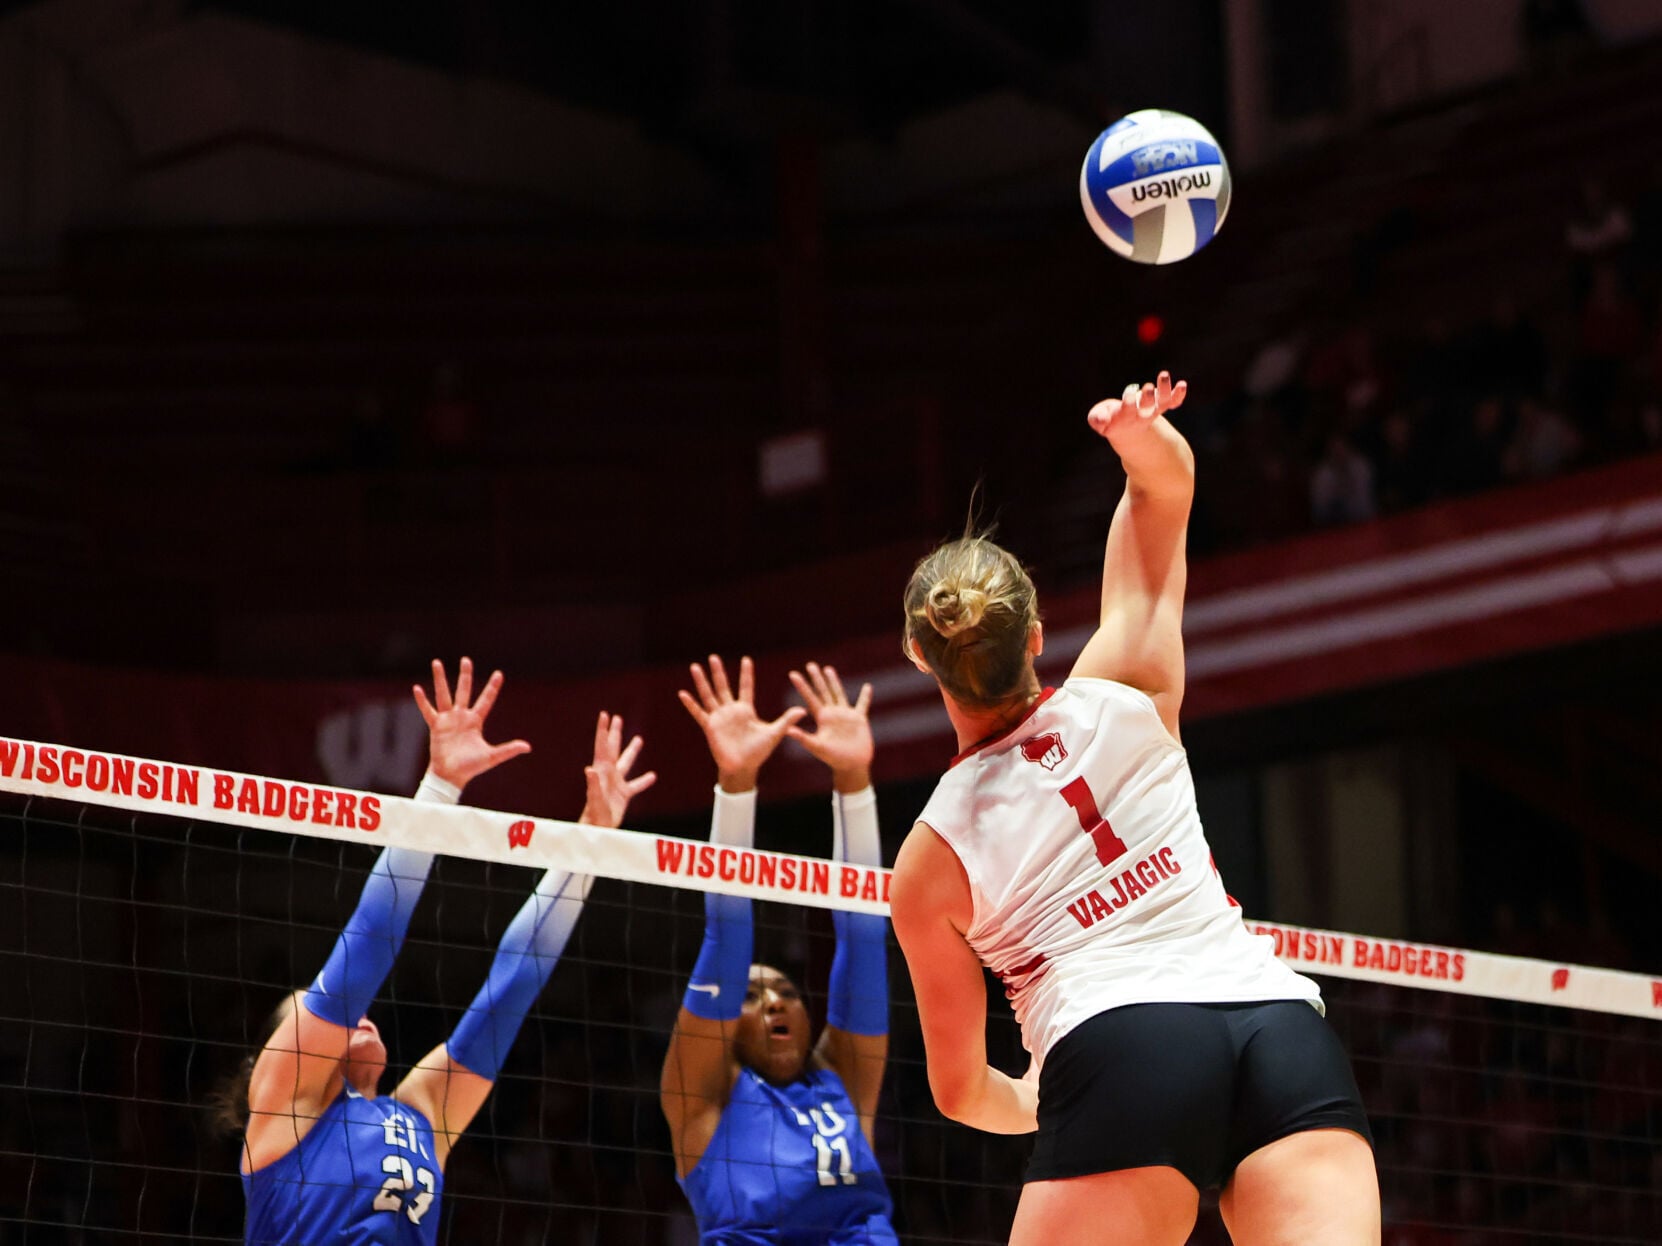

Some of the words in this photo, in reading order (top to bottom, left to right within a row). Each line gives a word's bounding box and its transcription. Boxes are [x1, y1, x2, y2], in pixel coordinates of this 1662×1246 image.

[1132, 171, 1211, 201] molten
[0, 740, 199, 806] WISCONSIN
[213, 773, 381, 832] BADGERS
[507, 820, 535, 850] W
[1059, 775, 1128, 867] 1
[656, 839, 830, 896] WISCONSIN
[1066, 847, 1182, 929] VAJAGIC
[1353, 939, 1465, 982] BADGERS
[381, 1113, 429, 1161] EI
[812, 1132, 858, 1186] 11
[373, 1155, 435, 1225] 23
